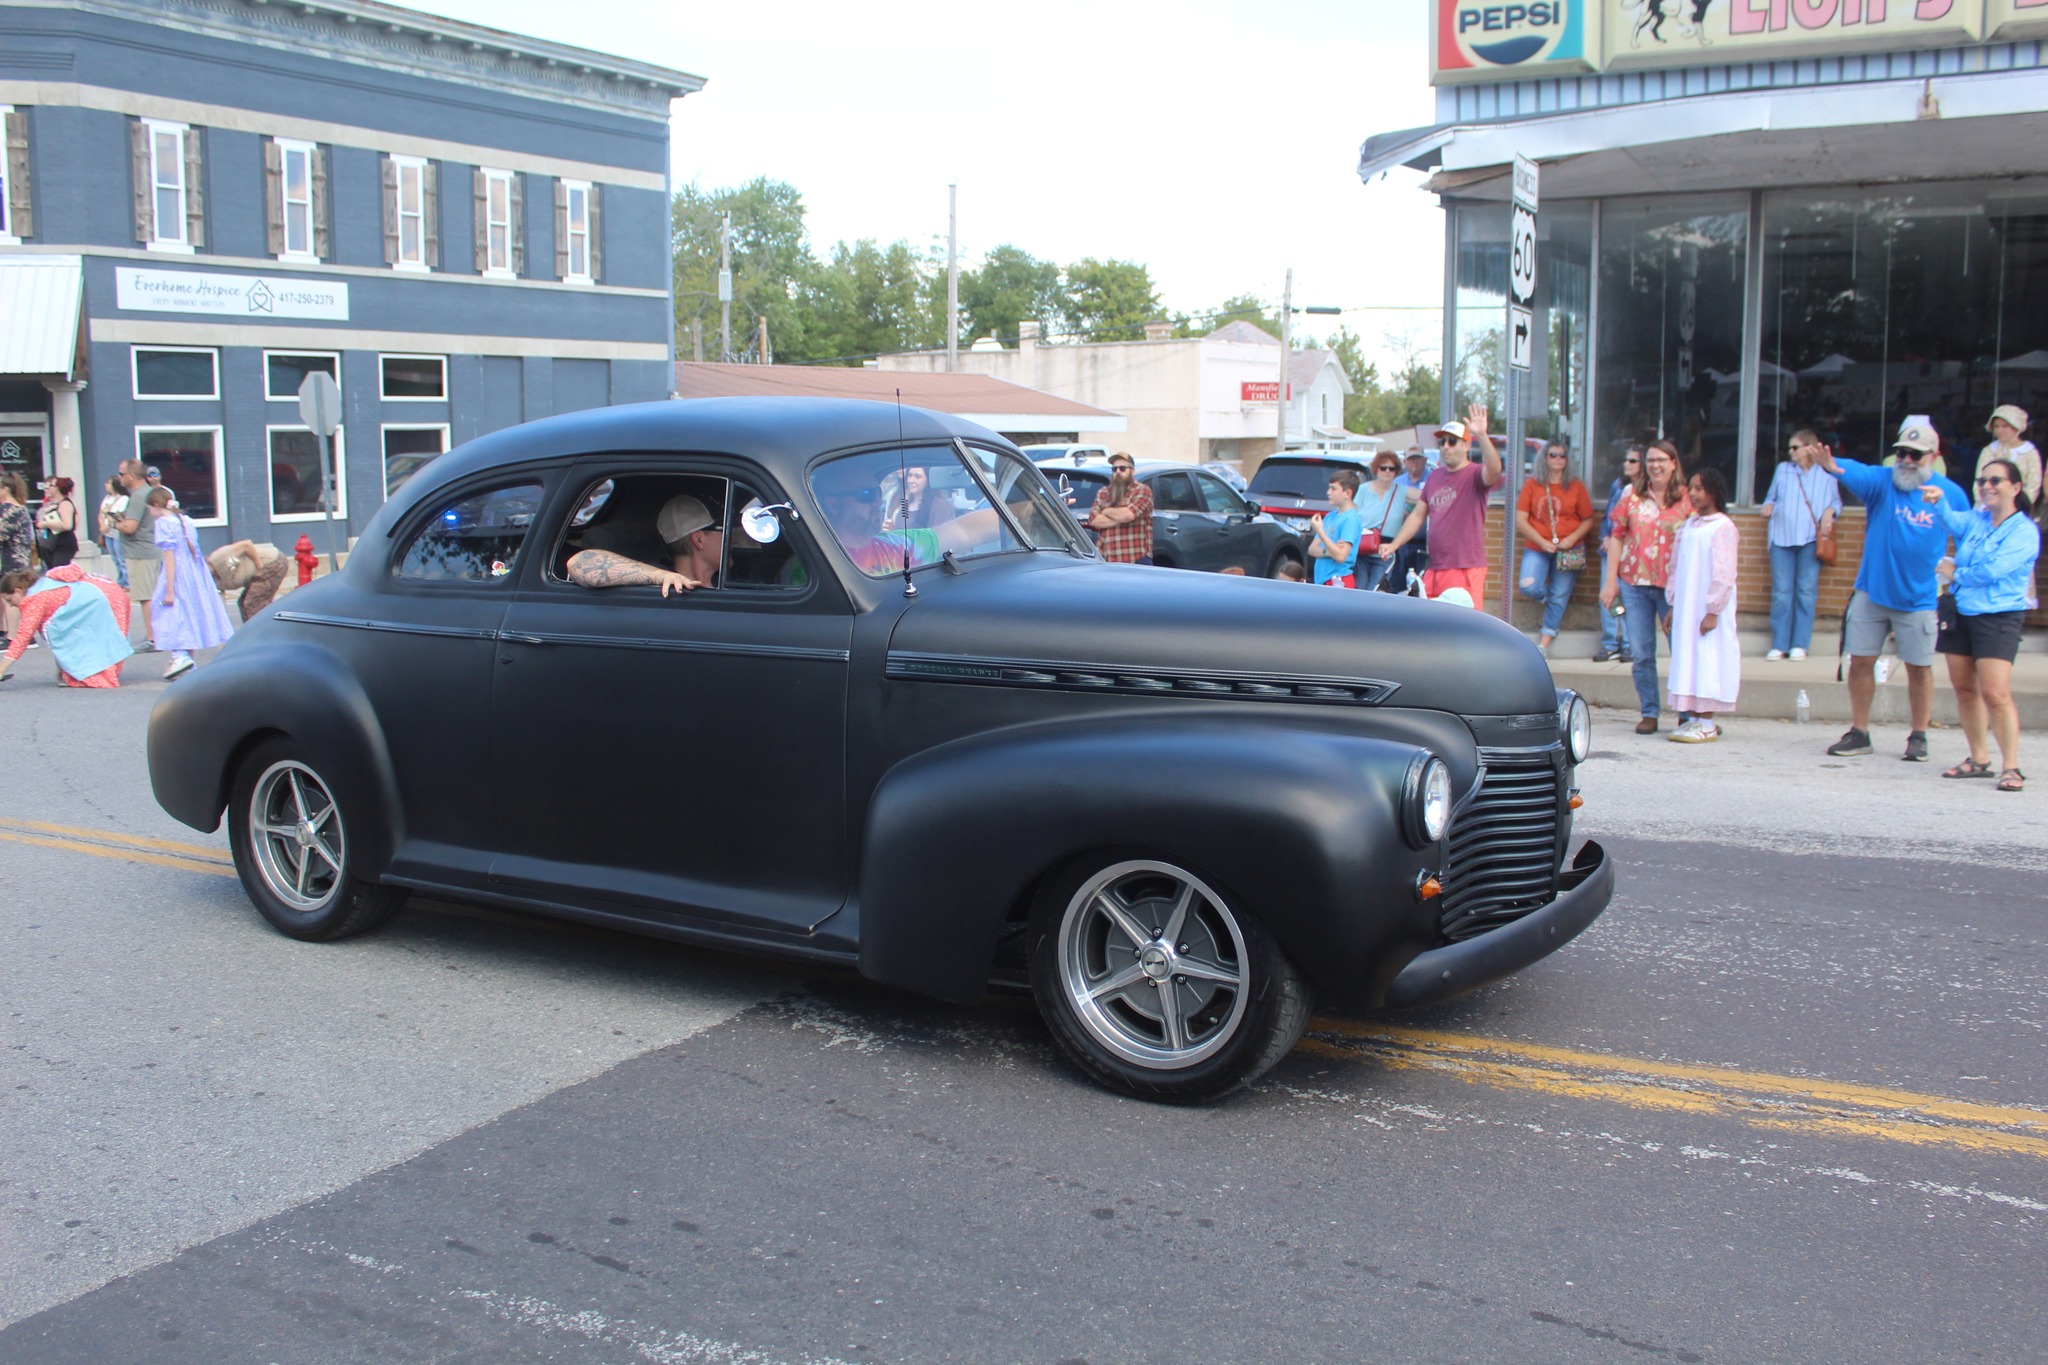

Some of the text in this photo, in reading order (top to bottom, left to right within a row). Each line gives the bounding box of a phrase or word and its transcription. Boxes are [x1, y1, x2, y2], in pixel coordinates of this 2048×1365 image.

[1459, 1, 1560, 33] PEPSI
[1514, 230, 1533, 281] 60
[134, 274, 240, 298] Everhome Hospice
[279, 293, 334, 306] 417-250-2379
[1246, 383, 1279, 392] Mansfie
